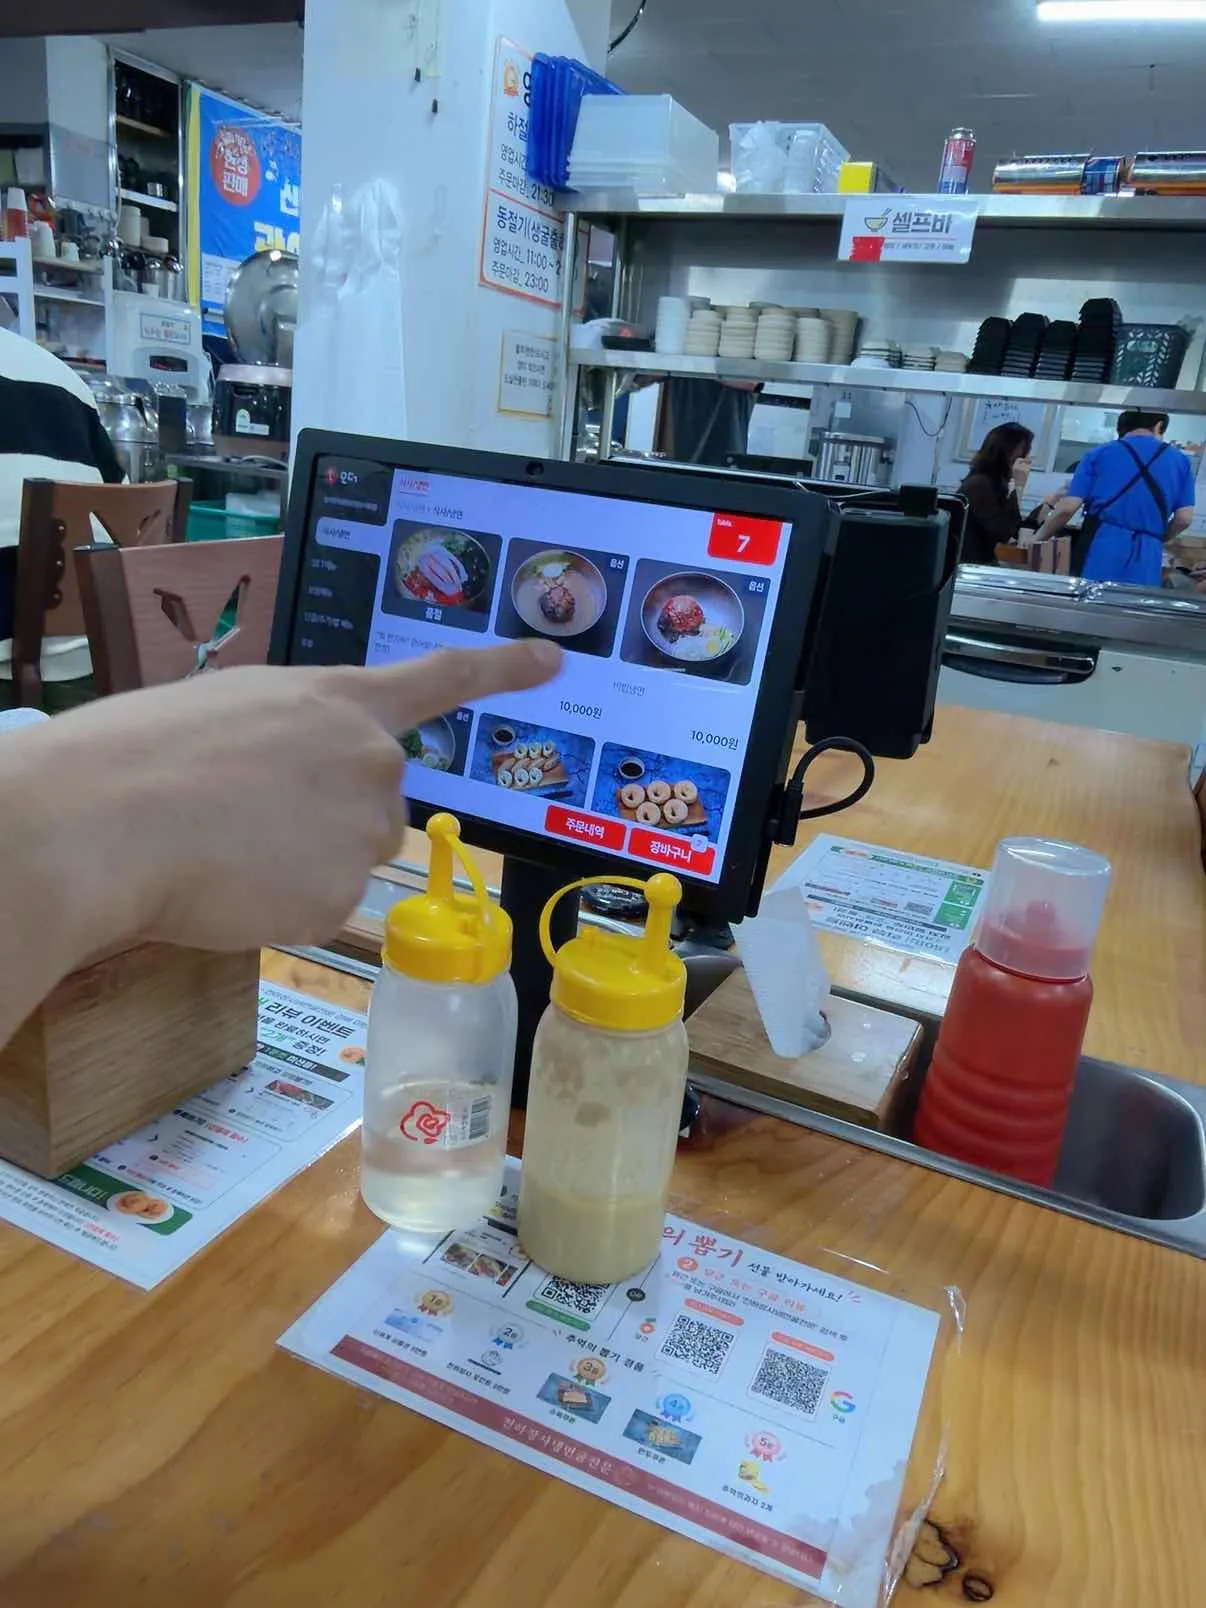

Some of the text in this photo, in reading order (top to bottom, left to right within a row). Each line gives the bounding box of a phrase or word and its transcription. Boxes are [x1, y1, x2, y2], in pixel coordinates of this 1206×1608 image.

[507, 112, 529, 142] 하절
[892, 212, 952, 234] 셀프바
[525, 272, 549, 293] 23:00
[736, 534, 751, 553] 7
[748, 581, 765, 593] 옵션
[559, 700, 602, 720] 10,000원
[691, 730, 739, 751] 10,000원
[565, 817, 605, 839] 주문내역
[649, 840, 692, 863] 장바구니
[265, 1002, 303, 1019] 리뷰
[300, 1015, 355, 1039] 이벤트
[688, 1233, 743, 1268] 뽑기
[747, 1262, 773, 1278] 선물
[776, 1272, 844, 1303] 받아가세요!
